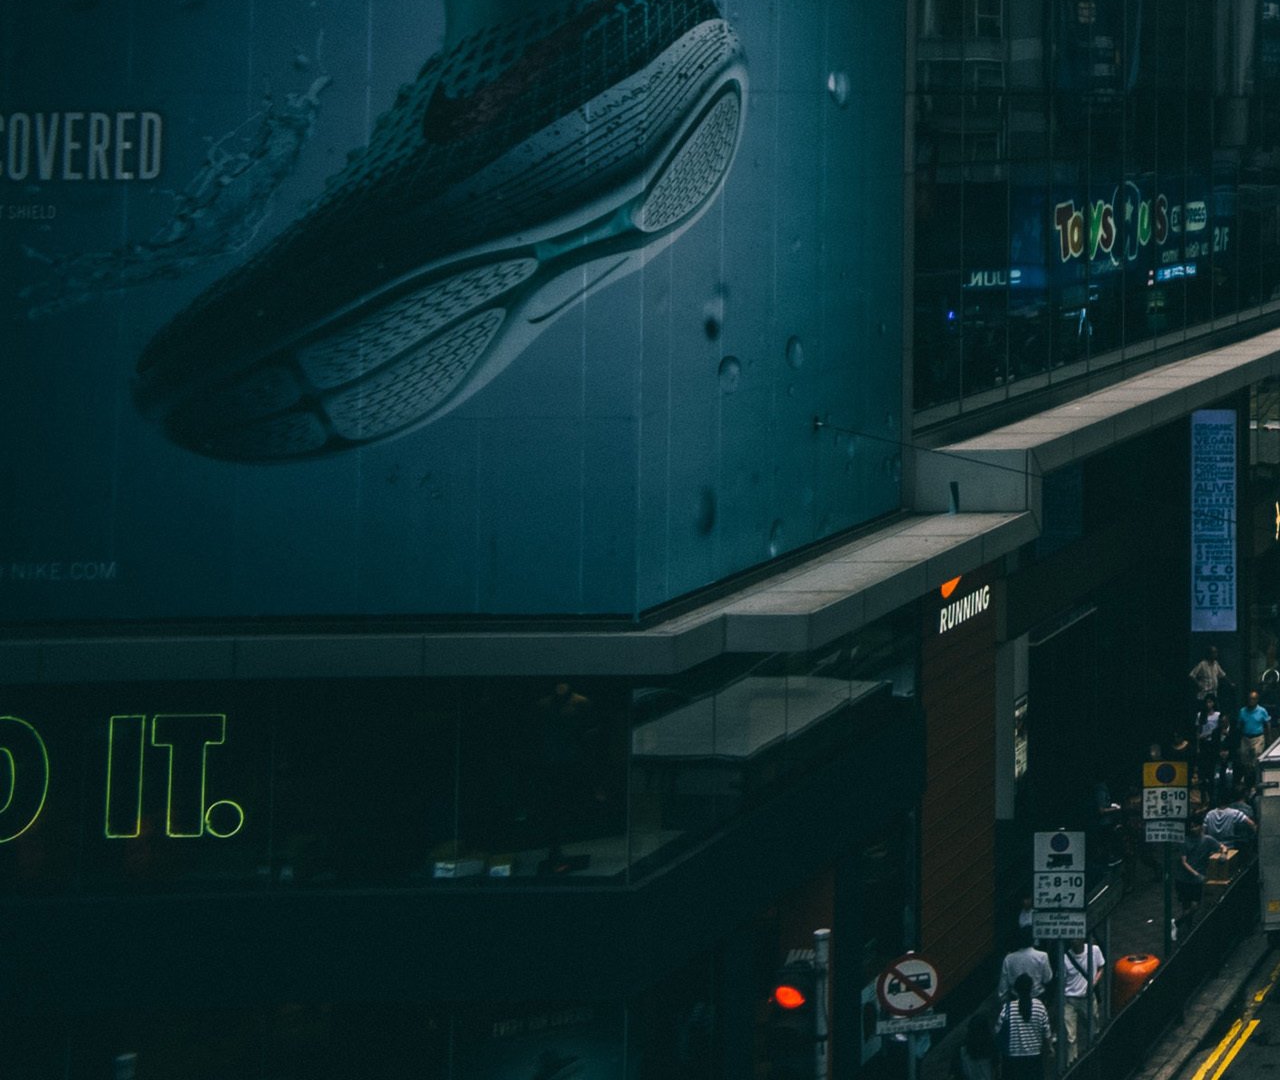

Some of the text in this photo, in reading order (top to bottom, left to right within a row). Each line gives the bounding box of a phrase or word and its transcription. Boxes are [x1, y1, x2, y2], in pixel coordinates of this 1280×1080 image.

[0, 111, 163, 181] OVERED
[8, 204, 57, 221] SHIELD
[1194, 436, 1234, 445] VEGAN
[1194, 483, 1234, 493] ALIVE
[1194, 565, 1234, 575] ECO
[939, 584, 990, 635] RUNNING
[105, 713, 244, 839] IT.
[1160, 790, 1187, 801] 8-10
[1053, 876, 1083, 888] 8-10
[1054, 892, 1076, 904] 4-7
